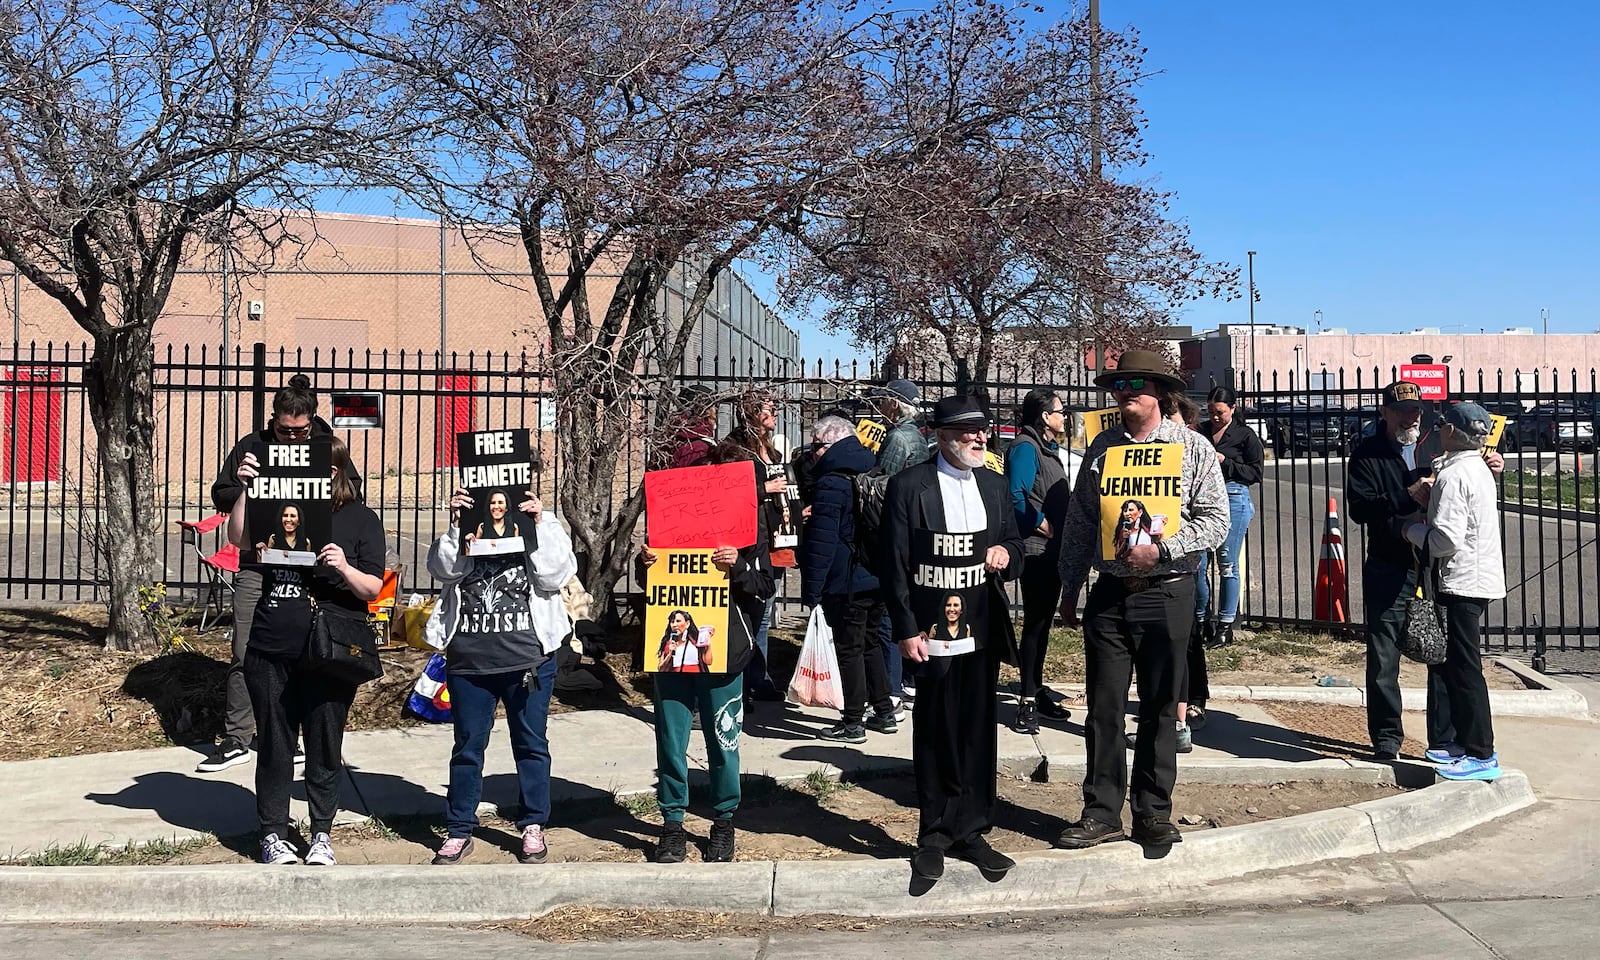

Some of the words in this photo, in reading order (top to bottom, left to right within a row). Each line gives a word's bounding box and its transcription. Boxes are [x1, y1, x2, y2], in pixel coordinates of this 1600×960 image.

[1403, 370, 1411, 378] NO
[1412, 370, 1444, 378] TRESPASSING
[1420, 386, 1442, 395] ASPASAR
[1100, 411, 1121, 430] FRE
[474, 431, 514, 456] FREE
[866, 425, 887, 444] FRE
[268, 444, 310, 467] FREE
[1123, 448, 1162, 467] FREE
[461, 462, 530, 489] JEANETTE
[1100, 476, 1181, 497] JEANETTE
[247, 477, 332, 500] JEANETTE
[660, 499, 726, 524] FREE
[933, 533, 974, 557] FREE
[668, 554, 708, 574] FREE
[914, 562, 987, 589] JEANETTE
[646, 585, 728, 608] JEANETTE
[460, 611, 530, 634] ASCISM
